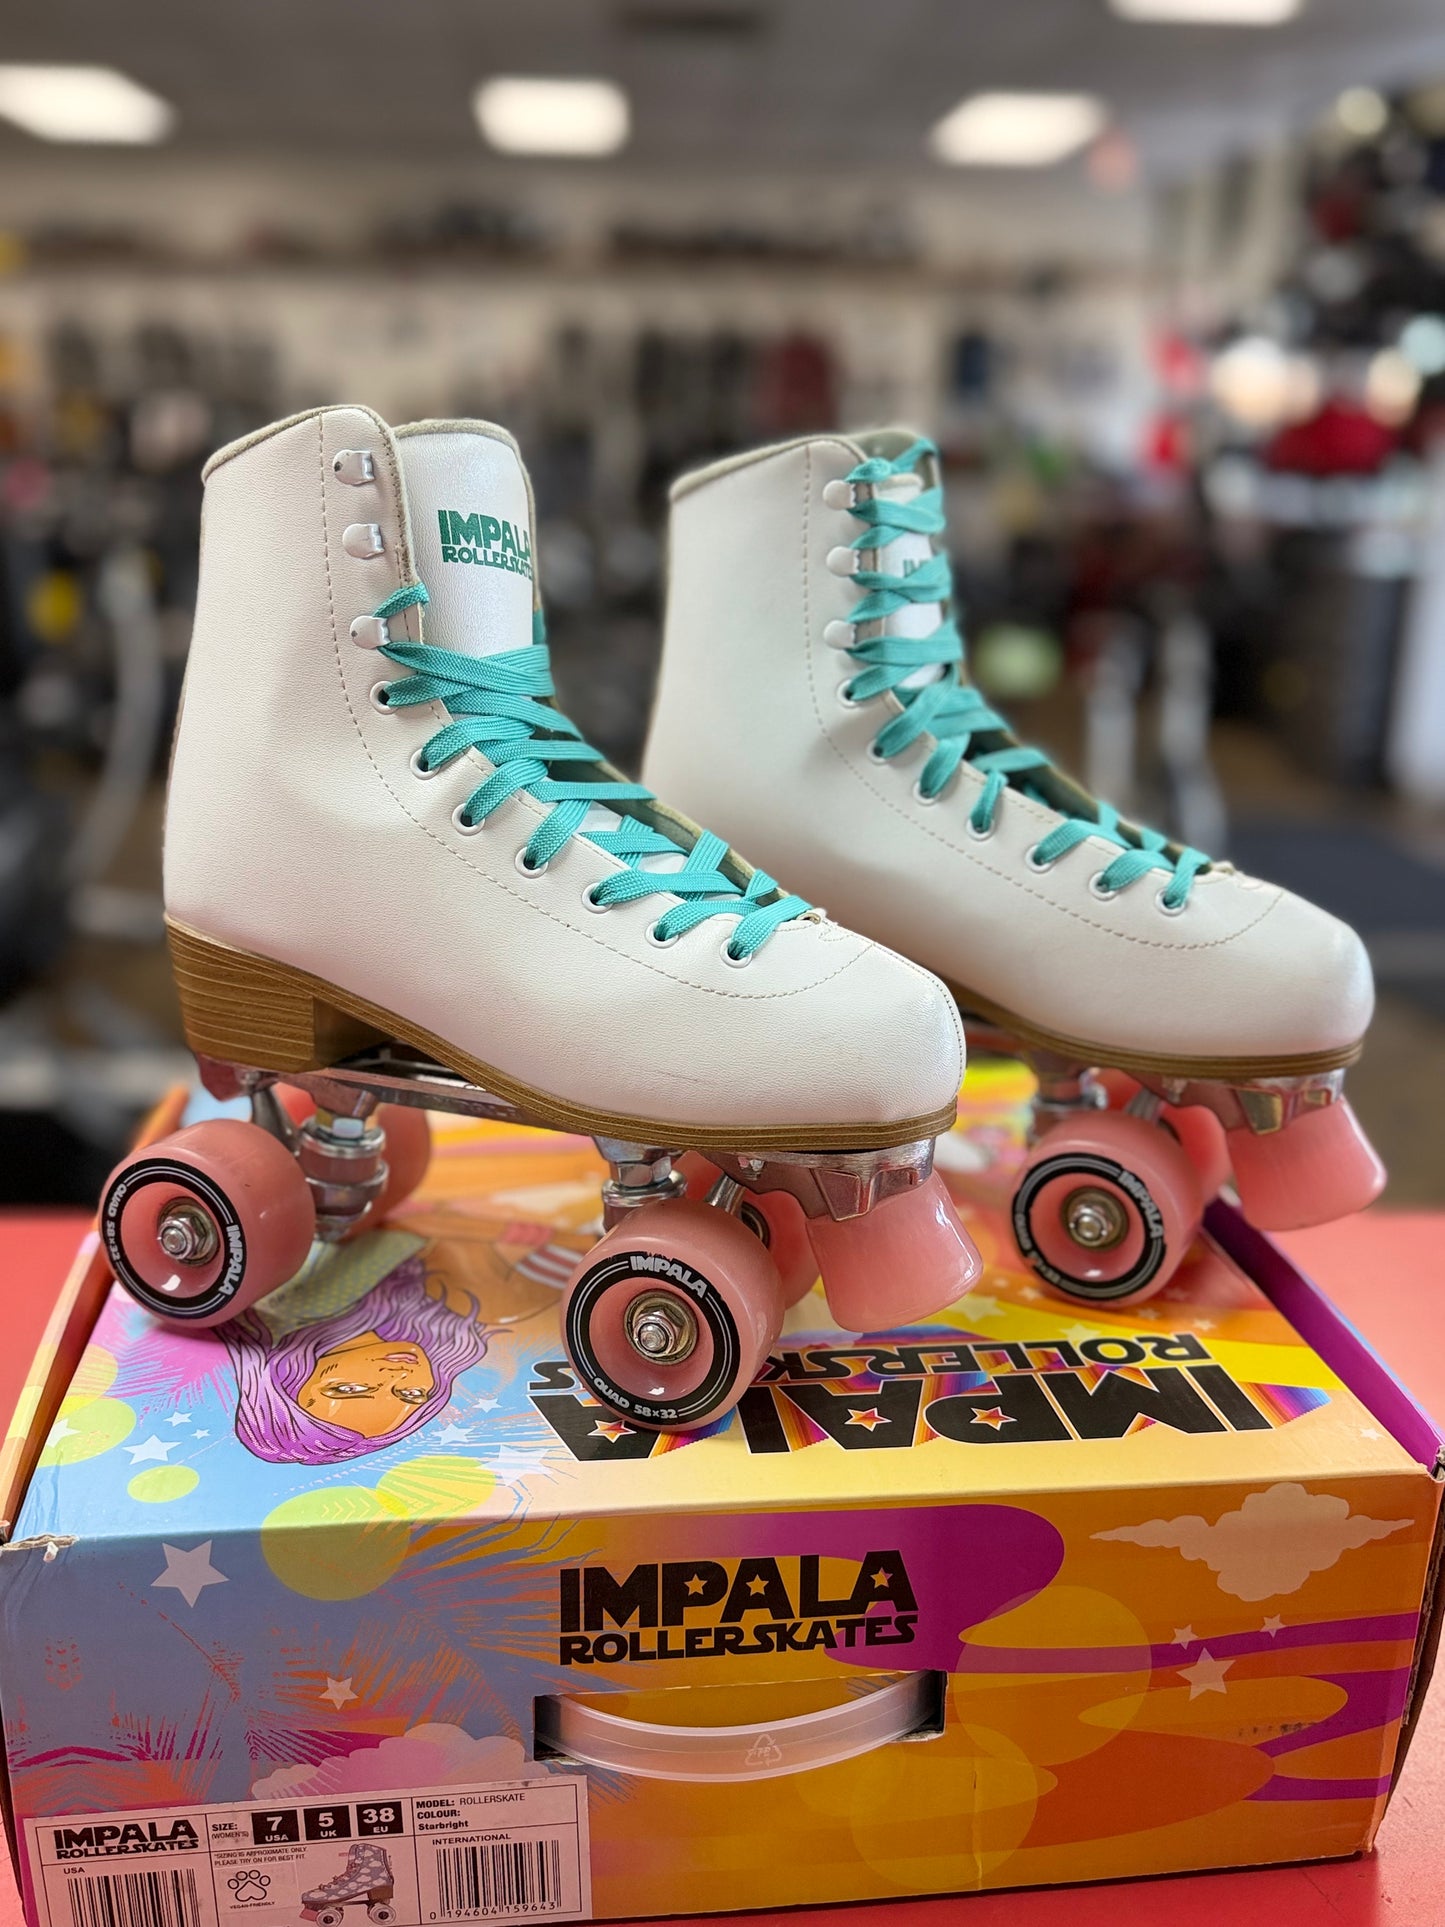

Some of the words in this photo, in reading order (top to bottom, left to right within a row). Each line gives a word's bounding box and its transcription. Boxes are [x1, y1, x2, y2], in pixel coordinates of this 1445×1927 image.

[107, 1183, 128, 1218] QUAD
[1118, 1169, 1164, 1239] IMPALA
[218, 1224, 243, 1296] IMPALA
[629, 1255, 709, 1299] IMPALA
[593, 1377, 630, 1409] QUAD
[559, 1549, 919, 1633] IMPALA
[559, 1614, 919, 1666] ROLLERSKATES
[415, 1799, 455, 1809] MODEL:
[459, 1793, 526, 1806] ROLLERSKATE
[266, 1815, 283, 1832] 7
[318, 1812, 335, 1828] 5
[362, 1807, 396, 1824] 38
[416, 1809, 461, 1820] COLOUR:
[418, 1820, 469, 1831] Starbright
[53, 1819, 199, 1850] IMPALA
[211, 1822, 238, 1832] SIZE:
[264, 1834, 289, 1842] USA
[320, 1829, 337, 1838] UK
[373, 1825, 389, 1834] EU
[56, 1838, 200, 1860] ROLLERSKATES
[432, 1833, 513, 1846] INTERNATIONAL
[63, 1867, 86, 1875] USA
[214, 1859, 238, 1867] PLEASE
[277, 1854, 294, 1862] BEST
[447, 1908, 498, 1919] 194604
[505, 1901, 556, 1914] 159643
